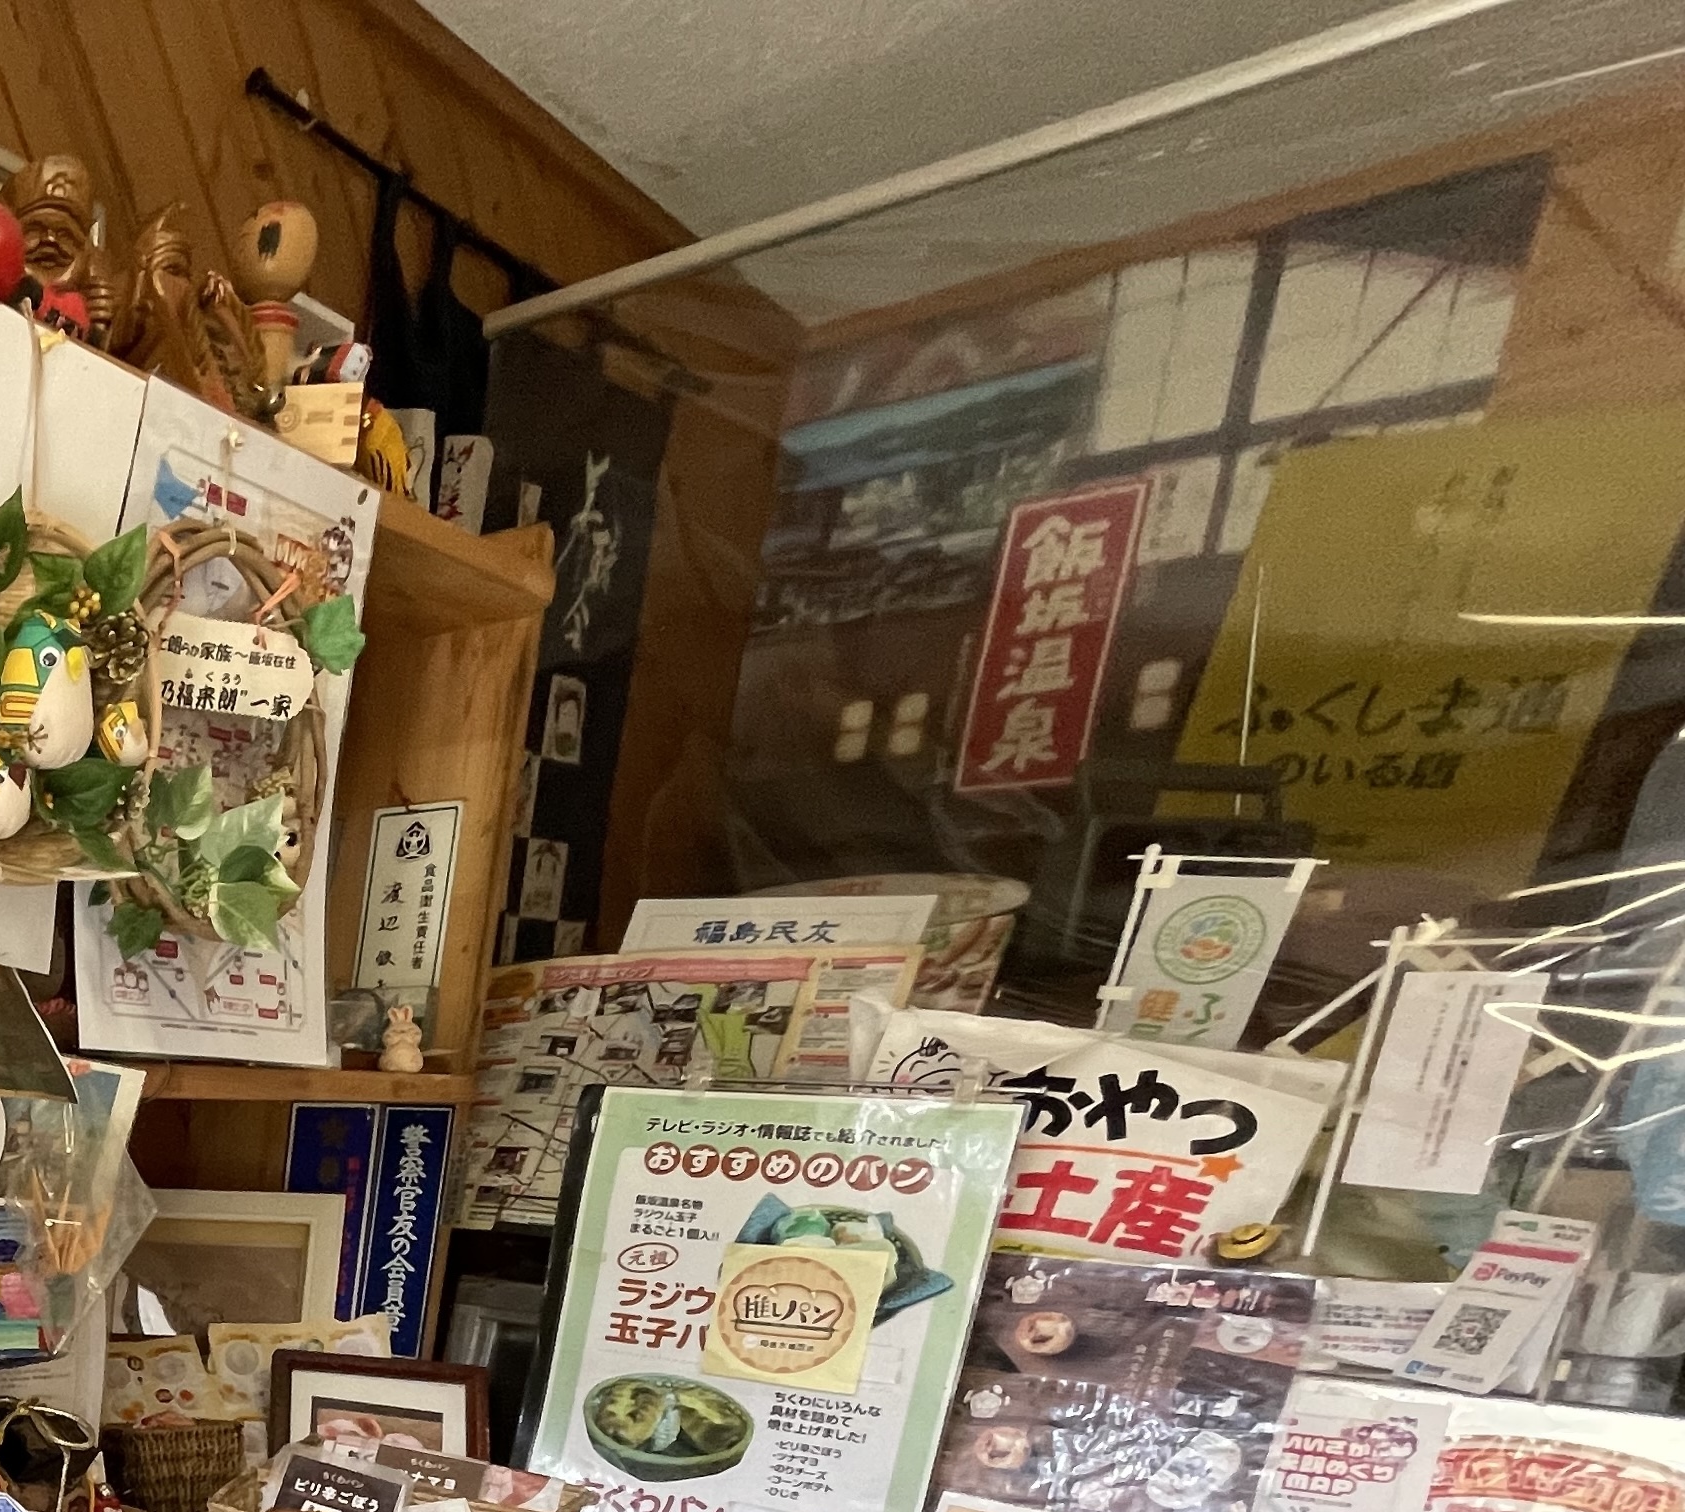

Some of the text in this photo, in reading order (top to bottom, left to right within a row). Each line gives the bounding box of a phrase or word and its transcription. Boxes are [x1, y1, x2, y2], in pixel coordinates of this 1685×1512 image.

[979, 514, 1110, 776] 飯坂温泉
[694, 919, 841, 944] 福島民友
[999, 1065, 1258, 1156] おやつ
[647, 1144, 932, 1192] おすすめのパン
[998, 1160, 1215, 1259] 土産
[627, 1250, 669, 1267] 元祖
[1495, 1266, 1552, 1289] PayPay
